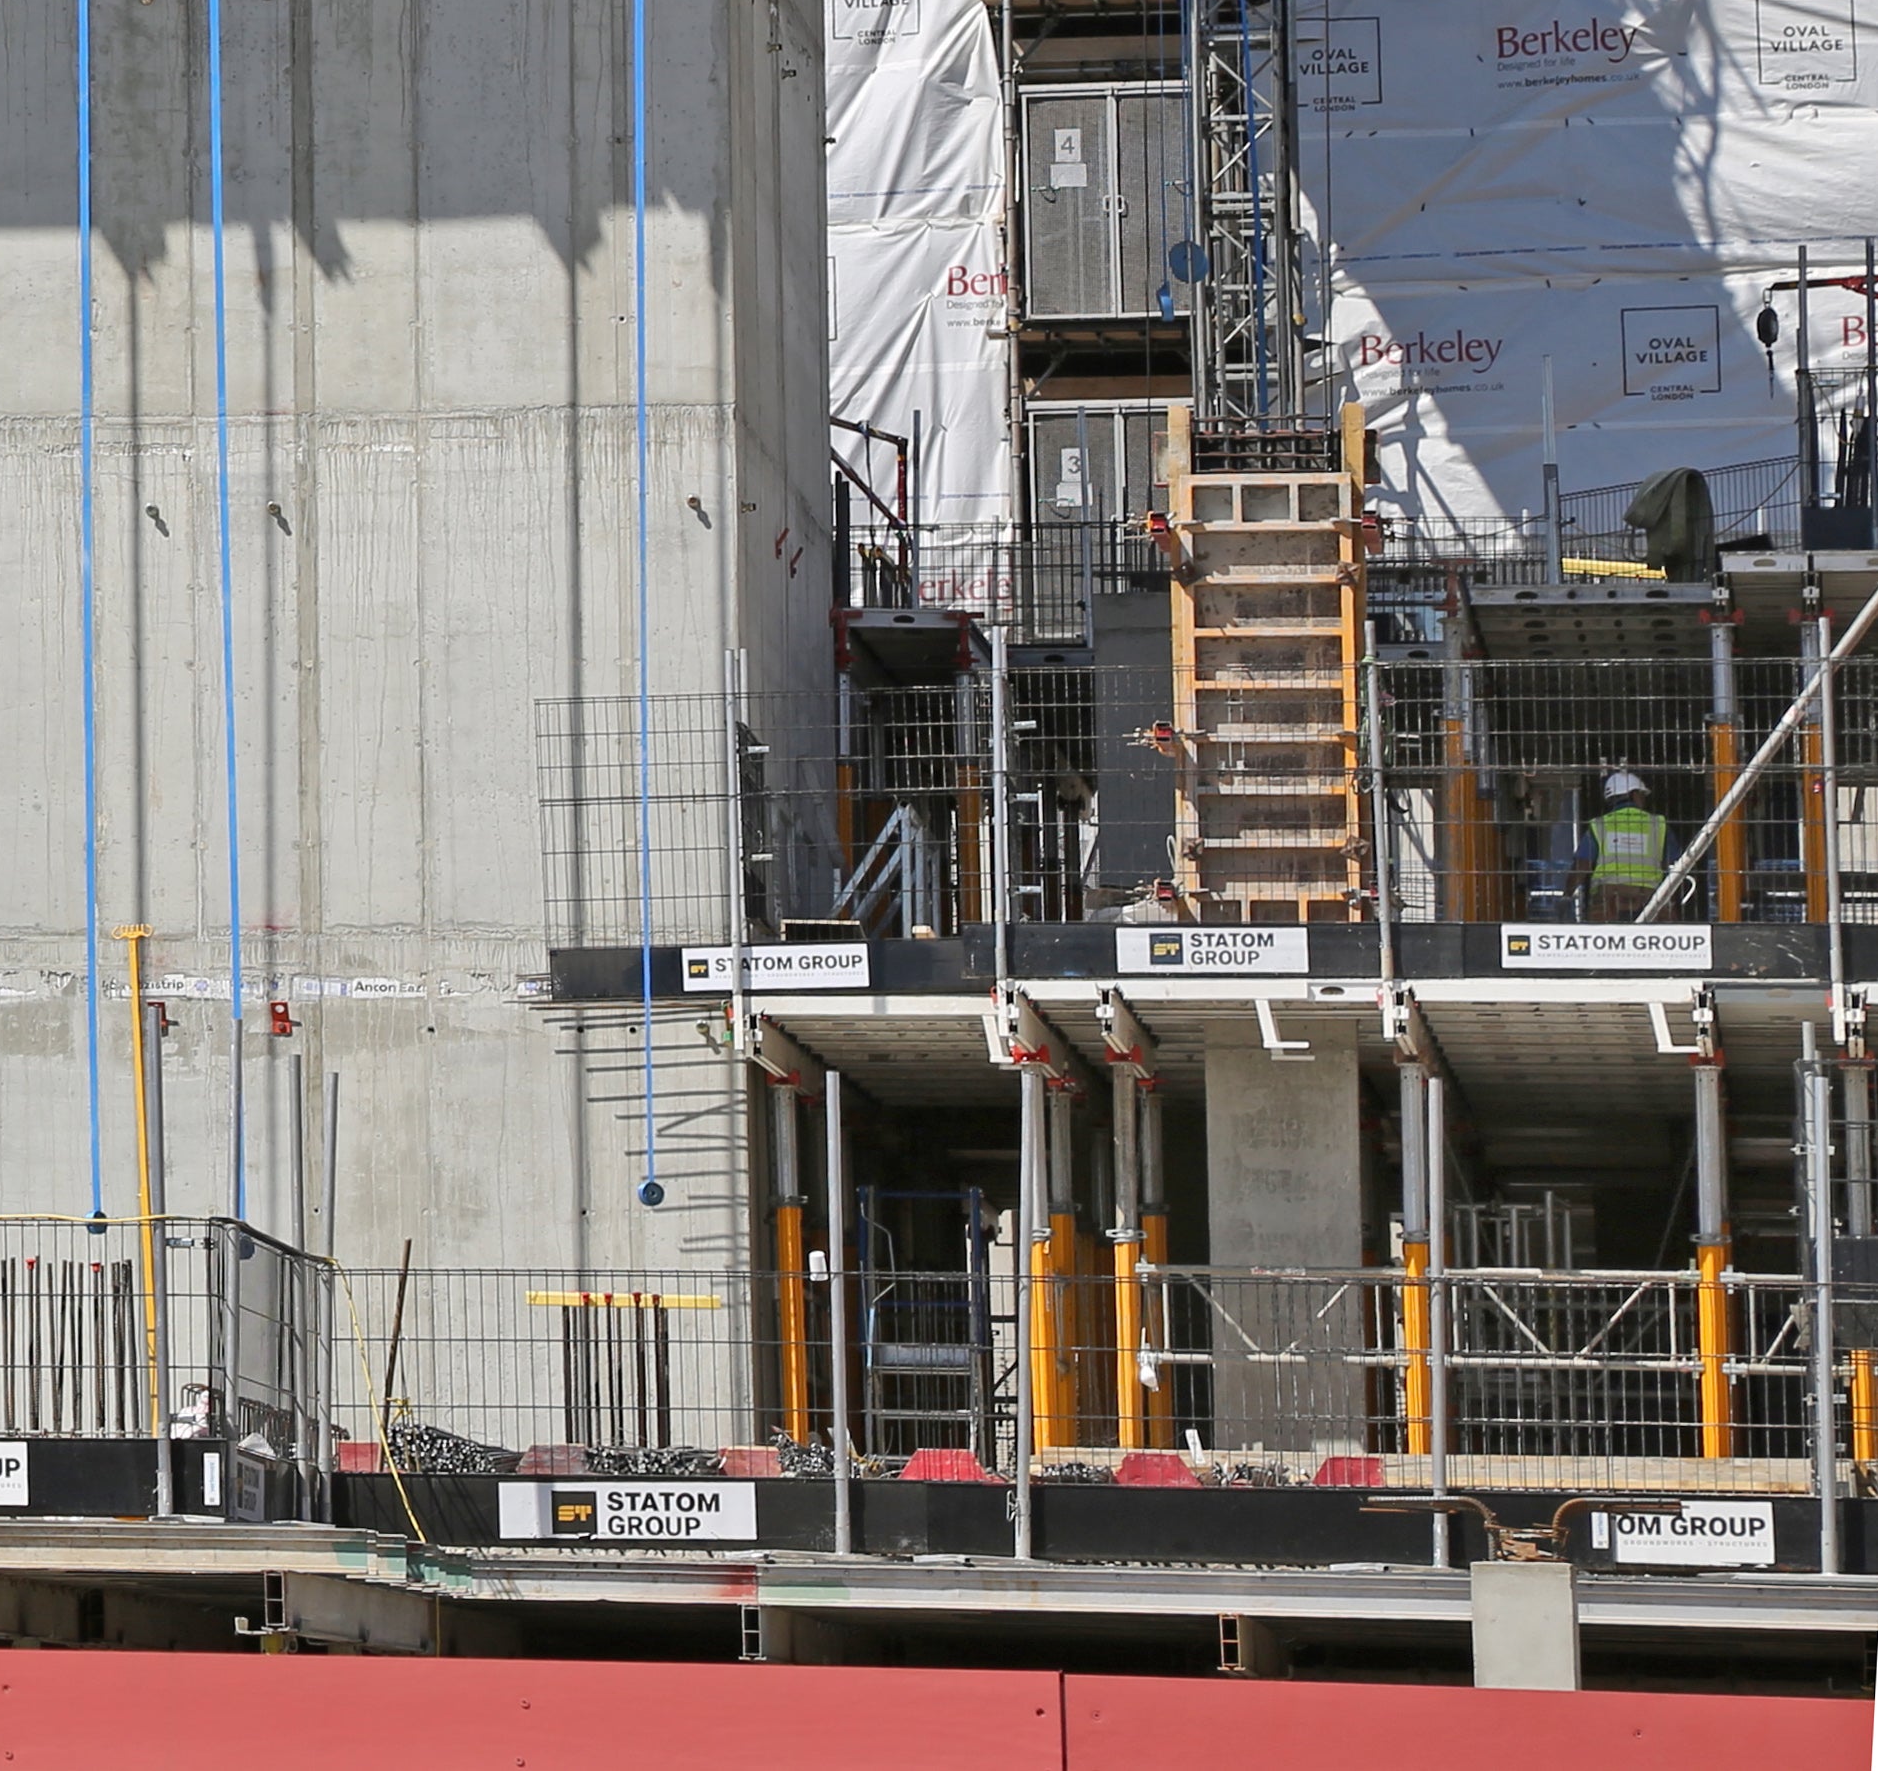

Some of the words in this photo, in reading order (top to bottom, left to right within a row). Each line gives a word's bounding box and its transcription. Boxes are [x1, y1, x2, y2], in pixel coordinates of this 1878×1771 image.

[857, 30, 897, 38] CENTRAL
[1783, 25, 1830, 38] OVAL
[858, 37, 897, 46] LONDON
[1497, 18, 1637, 64] Berkeley
[1770, 39, 1844, 52] VILLAGE
[1311, 48, 1357, 61] OVAL
[1299, 61, 1370, 75] VILLAGE
[1497, 59, 1541, 73] Designed
[1544, 57, 1557, 68] for
[1559, 56, 1576, 67] life
[1784, 74, 1830, 82] CENTRAL
[1786, 82, 1830, 90] LONDON
[1060, 135, 1075, 155] 4
[1649, 337, 1695, 351] OVAL
[1361, 329, 1503, 374] Berkeley
[1636, 350, 1709, 365] VILLAGE
[1425, 366, 1441, 377] life
[1650, 384, 1695, 394] CENTRAL
[1651, 392, 1695, 401] LONDON
[1067, 455, 1082, 475] 3
[1190, 932, 1275, 948] STATOM
[1537, 934, 1626, 951] STATOM
[1632, 934, 1706, 951] GROUP
[798, 955, 863, 970] GROUP
[1190, 950, 1260, 965] GROUP
[354, 981, 396, 993] Ancon
[607, 1491, 720, 1513] STATOM
[608, 1516, 701, 1536] GROUP
[1670, 1516, 1766, 1537] GROUP
